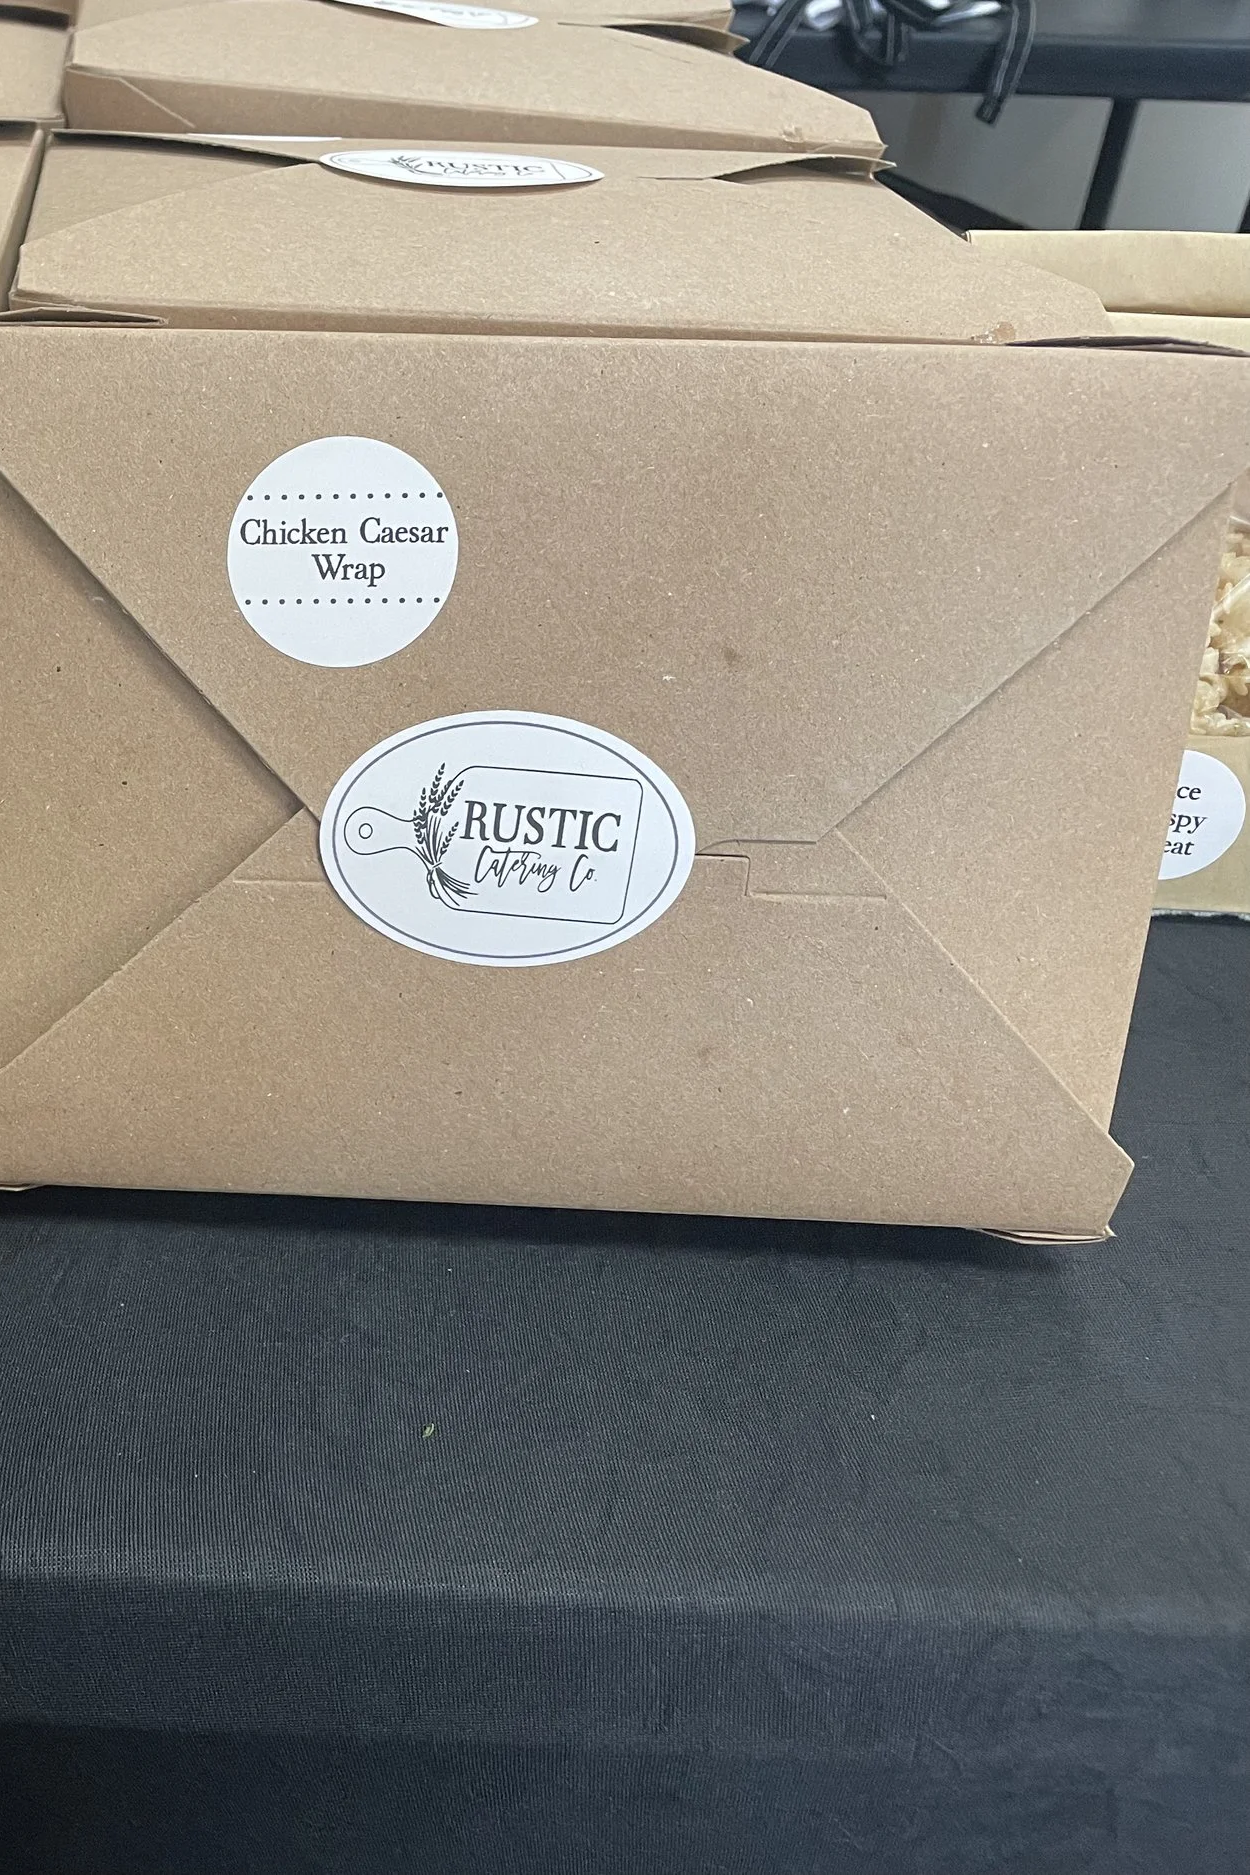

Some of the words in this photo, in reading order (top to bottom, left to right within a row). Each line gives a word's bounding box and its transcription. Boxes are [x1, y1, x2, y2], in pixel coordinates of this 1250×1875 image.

[240, 518, 348, 546] Chicken
[359, 517, 449, 544] Caesar
[311, 553, 386, 588] Wrap
[1176, 785, 1202, 801] ce
[459, 800, 622, 852] RUSTIC
[1168, 812, 1208, 834] spy
[1163, 839, 1195, 856] eat
[474, 845, 562, 893] Catering
